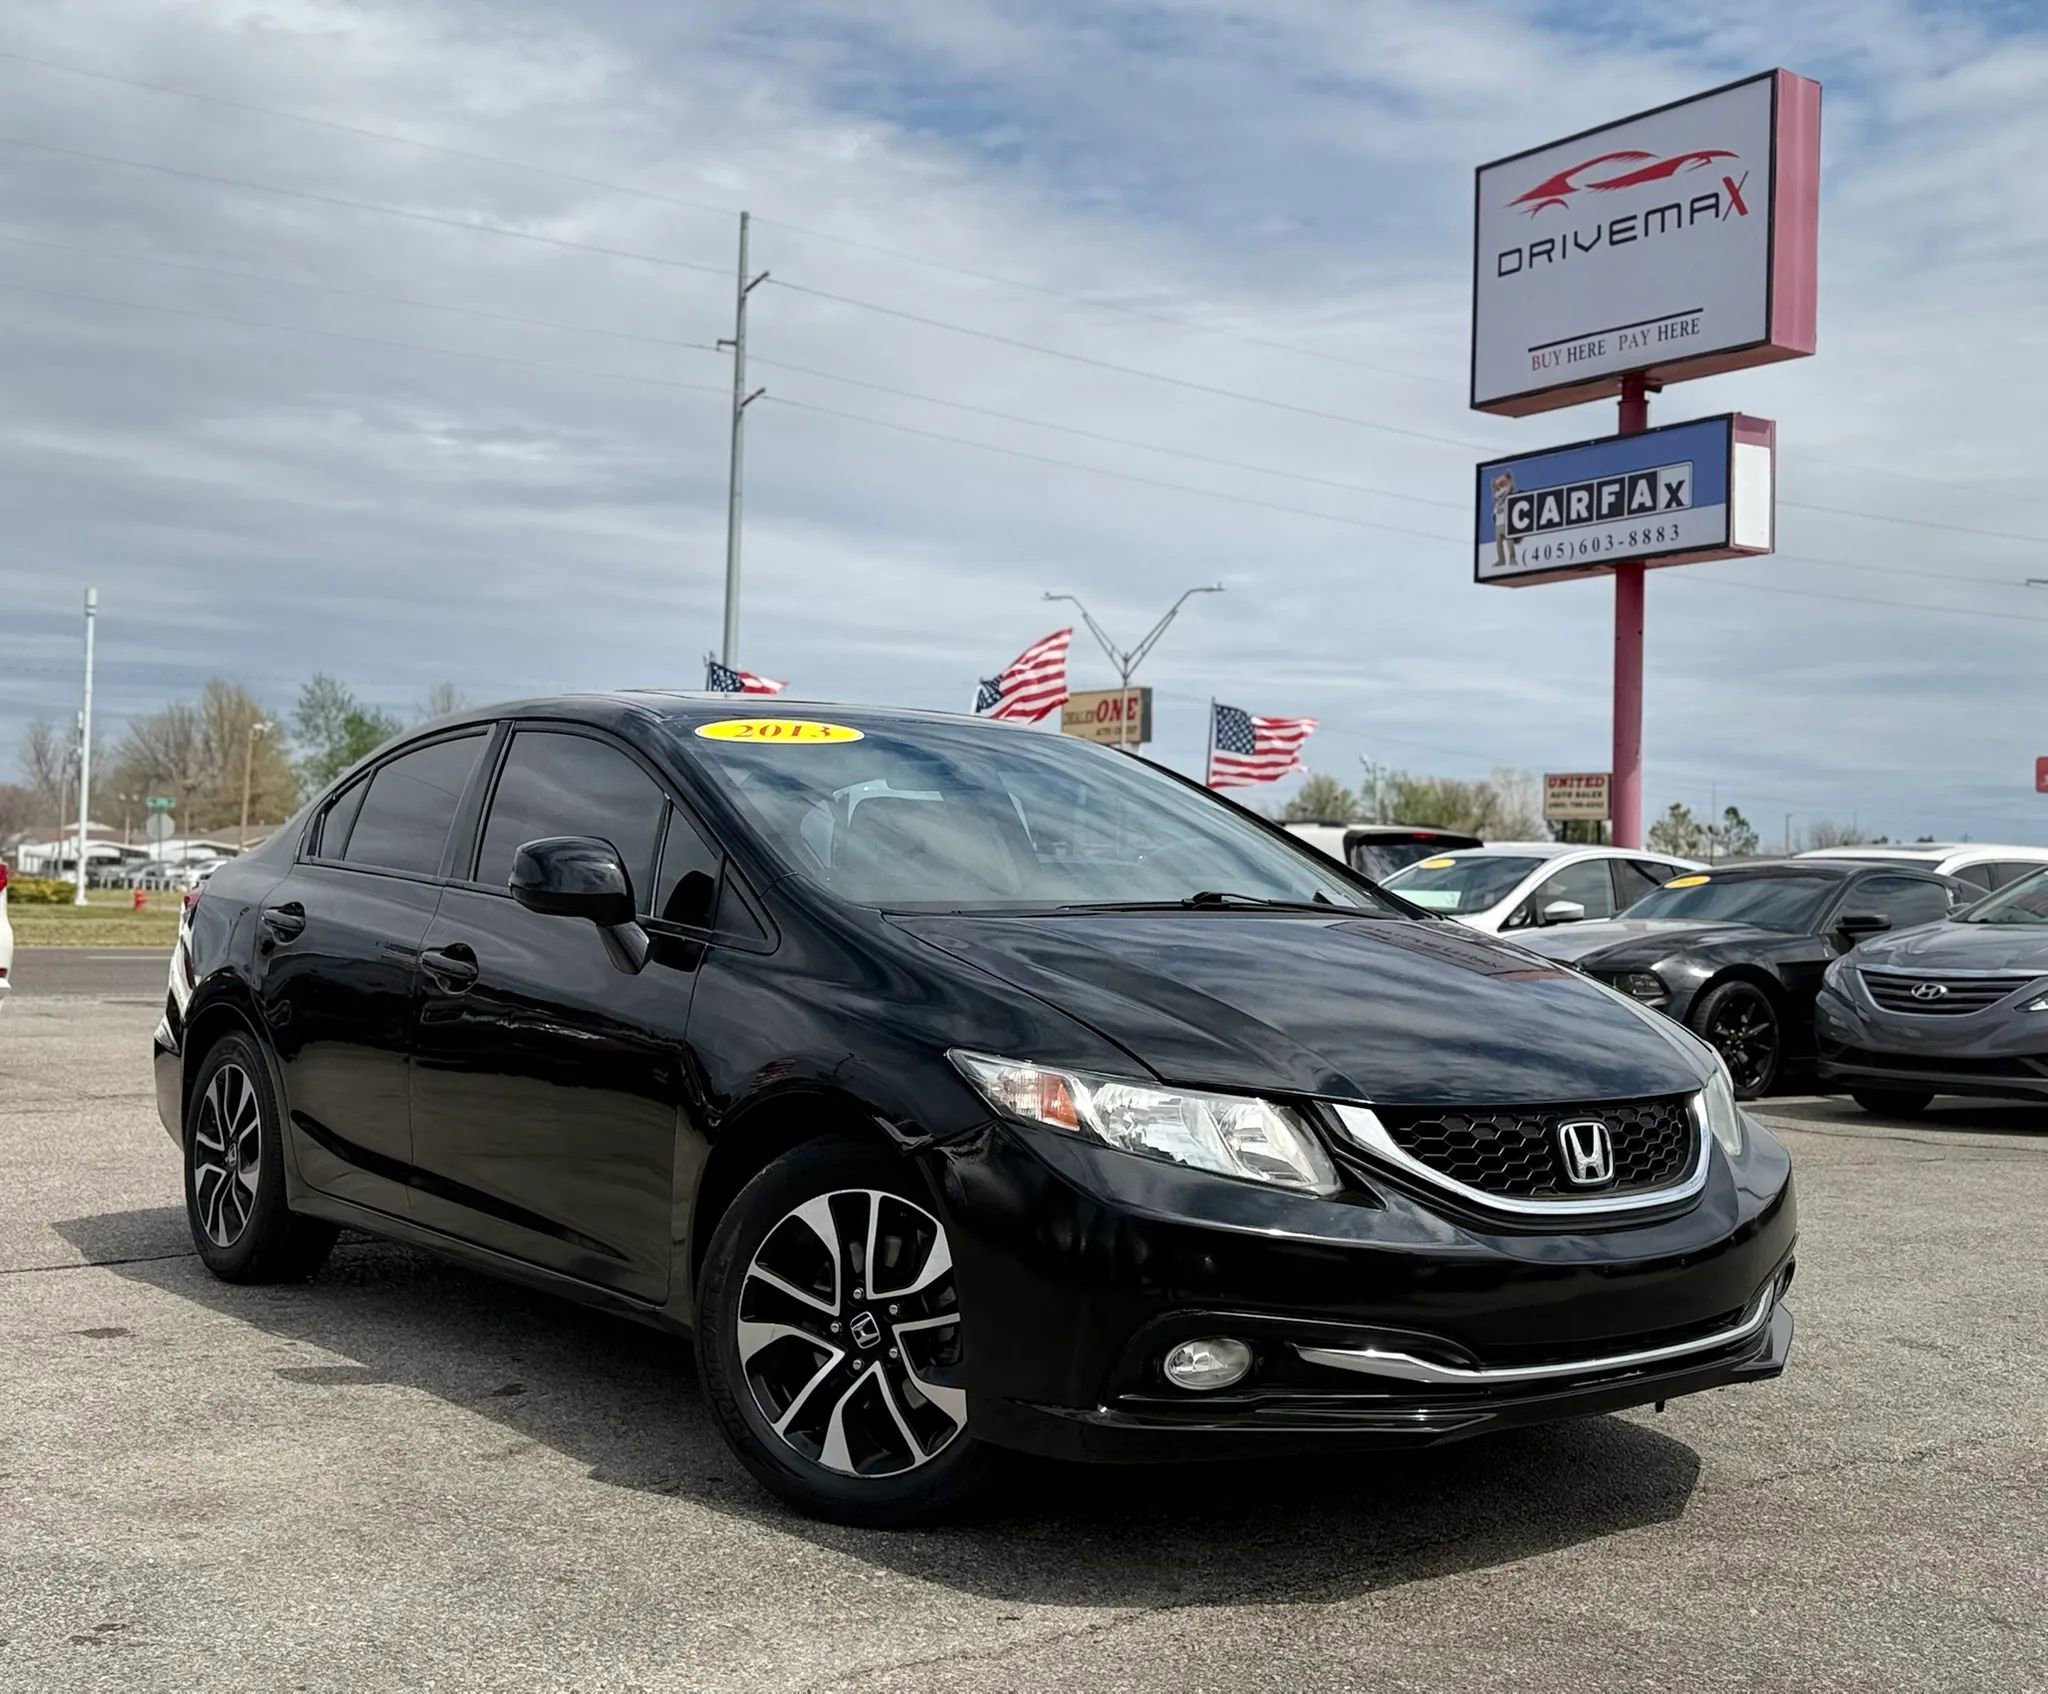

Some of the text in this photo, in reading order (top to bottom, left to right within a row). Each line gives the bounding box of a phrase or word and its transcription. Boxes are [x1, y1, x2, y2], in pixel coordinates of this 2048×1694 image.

[1498, 170, 1750, 278] DRIVEMAX
[1531, 317, 1701, 371] BUY HERE PAY HERE
[1511, 477, 1687, 530] CARFAX
[1521, 524, 1681, 567] (405)603-8883
[733, 724, 832, 738] 2013
[1096, 696, 1138, 723] ONE
[1548, 776, 1605, 788] UNITED
